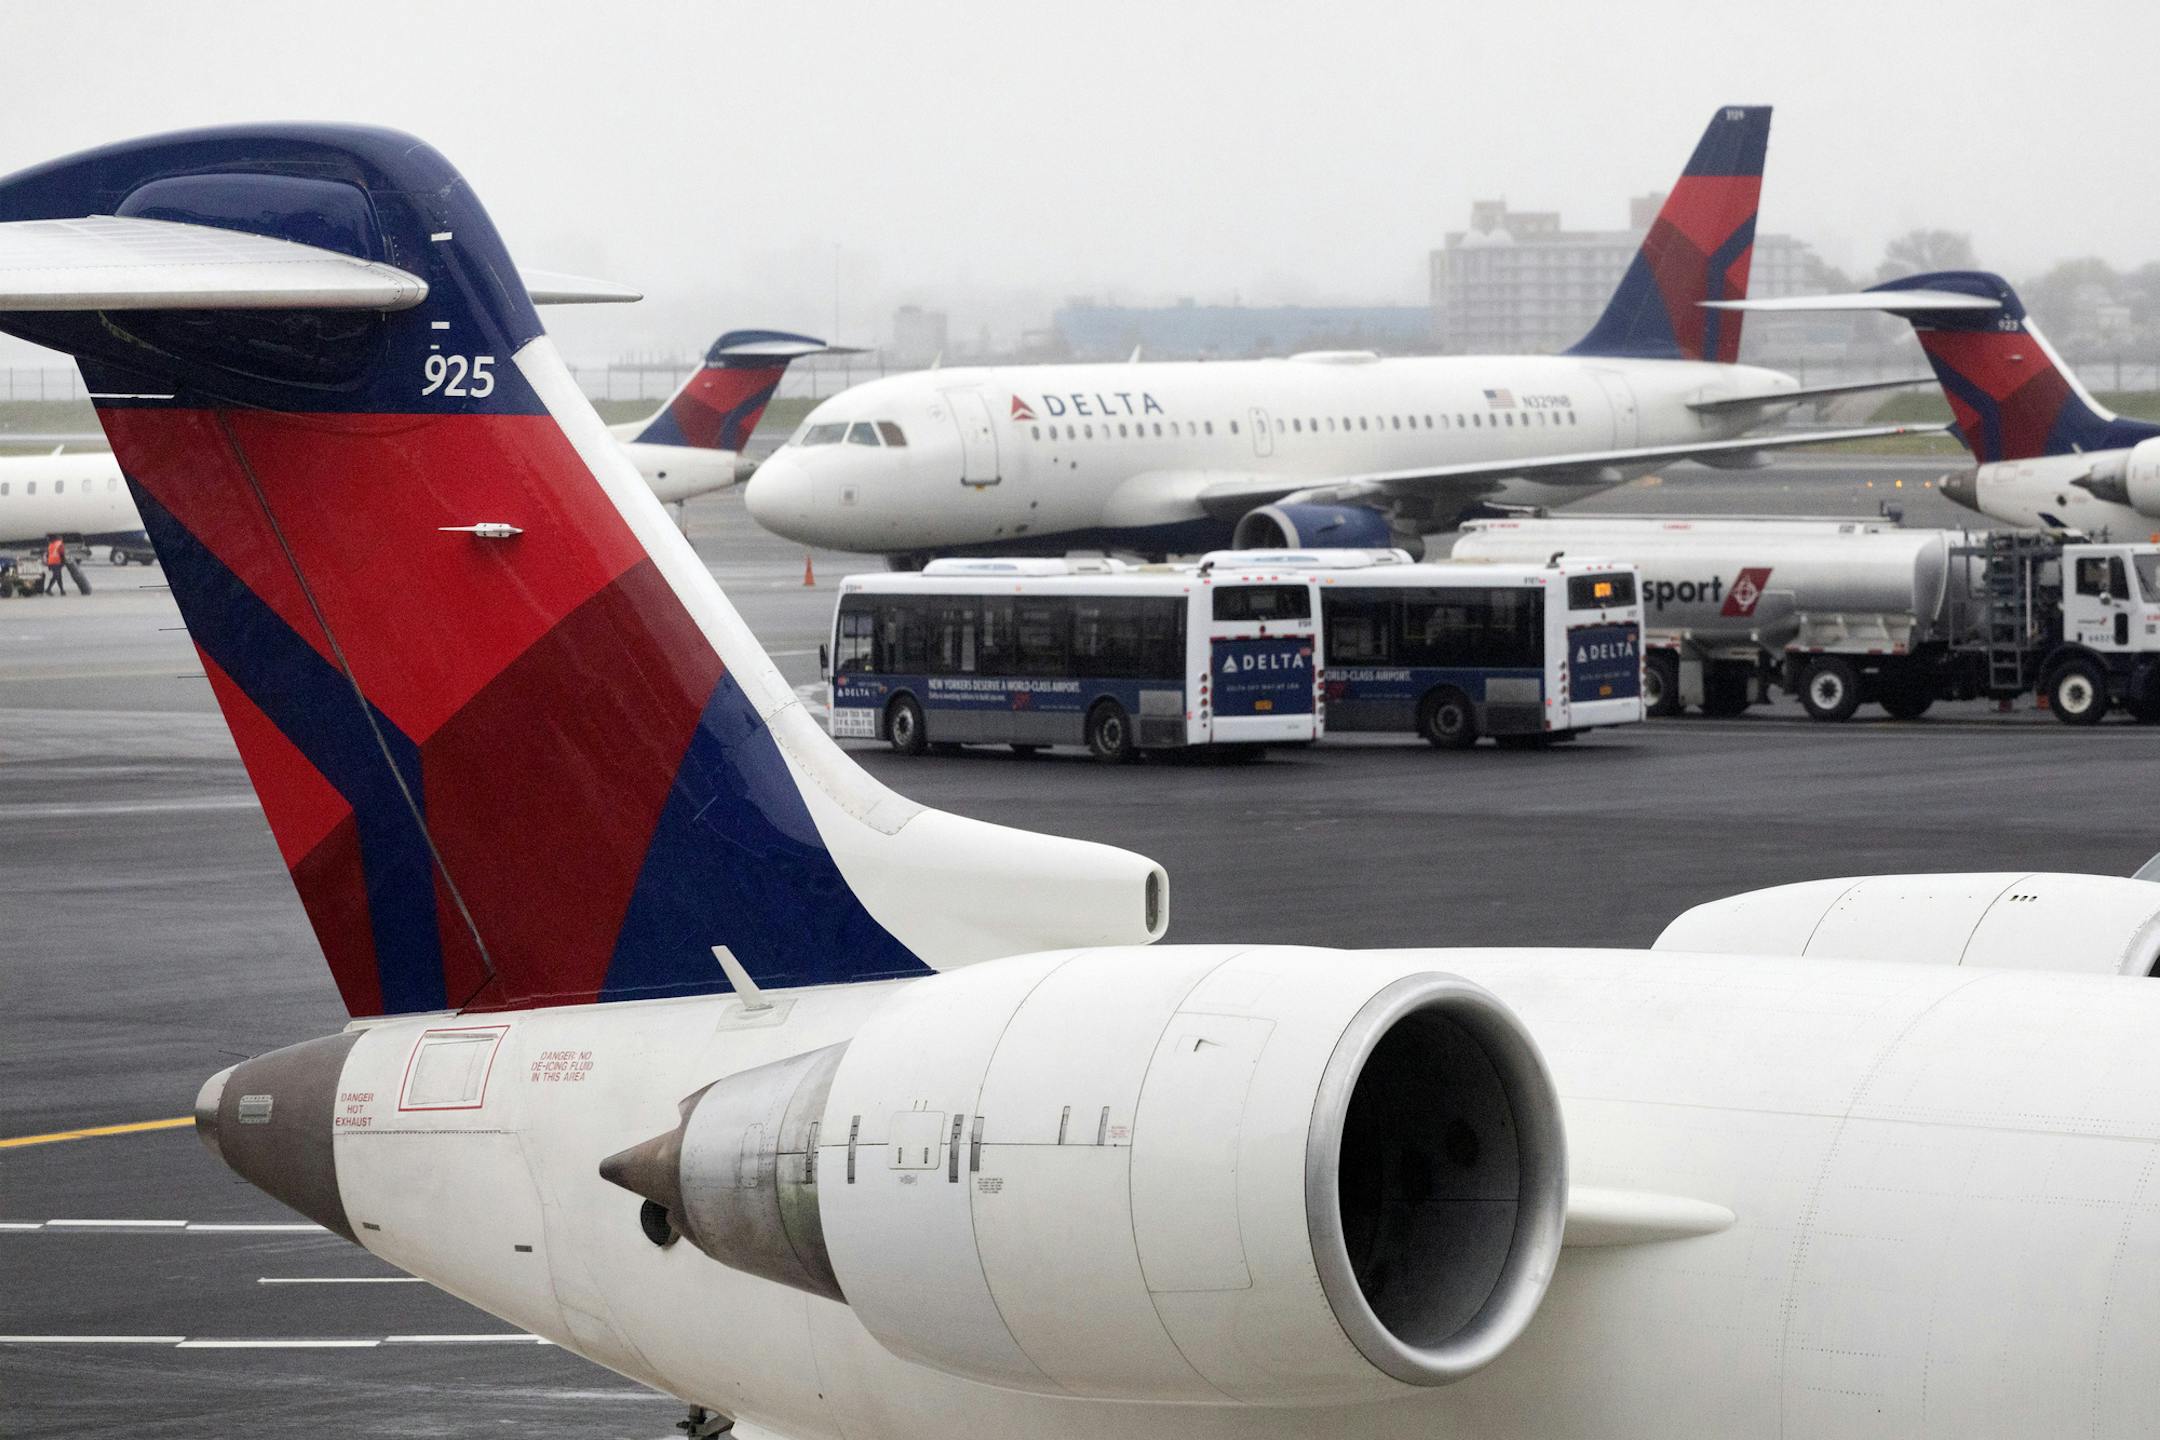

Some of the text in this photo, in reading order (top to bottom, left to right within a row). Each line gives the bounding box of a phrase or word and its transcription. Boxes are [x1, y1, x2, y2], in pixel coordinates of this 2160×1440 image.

[421, 354, 495, 398] 925
[1042, 393, 1164, 416] DELTA
[1590, 641, 1634, 660] DELTA
[1242, 653, 1304, 671] DELTA
[928, 679, 943, 690] NEW
[944, 679, 972, 690] YORKERS
[973, 679, 1001, 691] DESERVE
[844, 687, 870, 697] DELTA
[579, 1051, 593, 1061] NO
[530, 1061, 594, 1071] DE-ICING FLUID
[531, 1071, 585, 1082] IN THIS AREA
[340, 1092, 374, 1102] DANGER
[347, 1104, 364, 1114] HOT
[335, 1117, 372, 1127] EXHAUST
